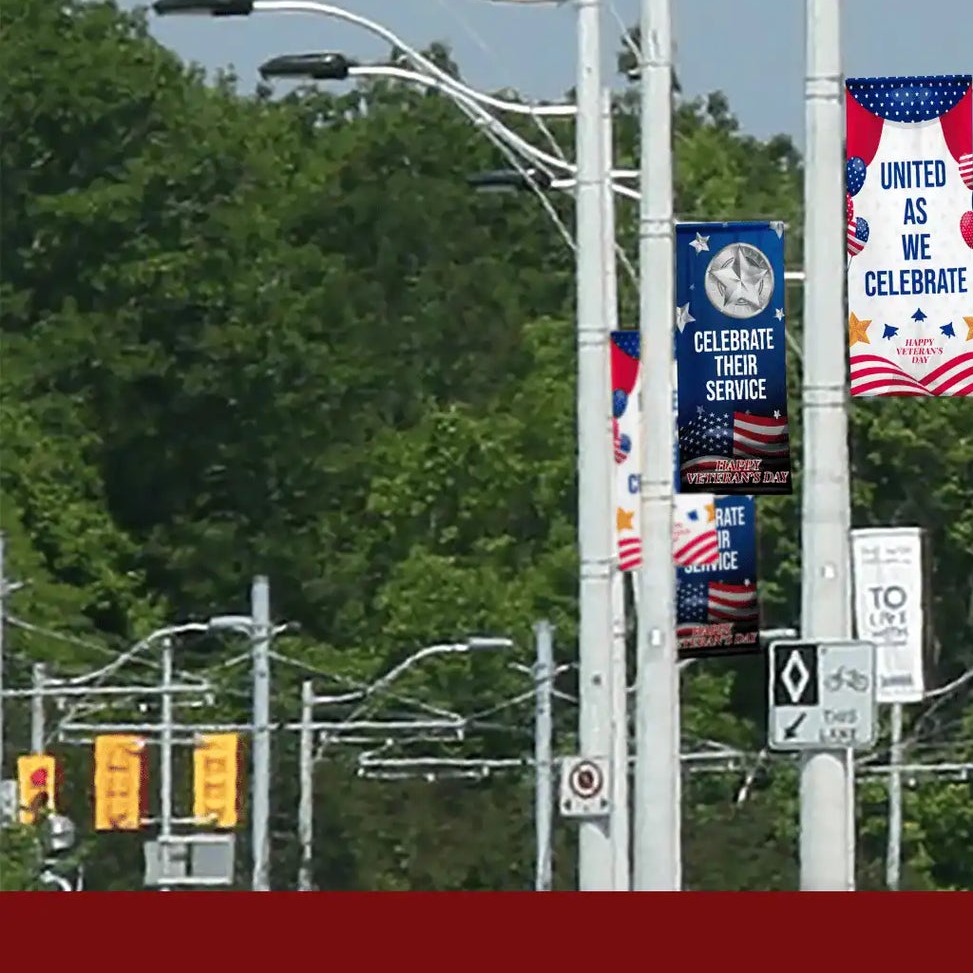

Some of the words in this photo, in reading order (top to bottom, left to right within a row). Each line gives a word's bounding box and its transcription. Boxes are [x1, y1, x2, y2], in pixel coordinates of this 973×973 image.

[880, 158, 947, 190] UNITED
[903, 196, 928, 226] AS
[901, 233, 932, 261] WE
[864, 267, 968, 297] CELEBRATE
[694, 328, 775, 353] CELEBRATE
[905, 338, 935, 347] HAPPY
[714, 354, 758, 377] THEIR
[911, 356, 930, 364] DAY
[705, 378, 767, 402] SERVICE
[715, 459, 762, 472] HAPPY
[762, 470, 790, 484] DAY
[869, 585, 907, 610] TO
